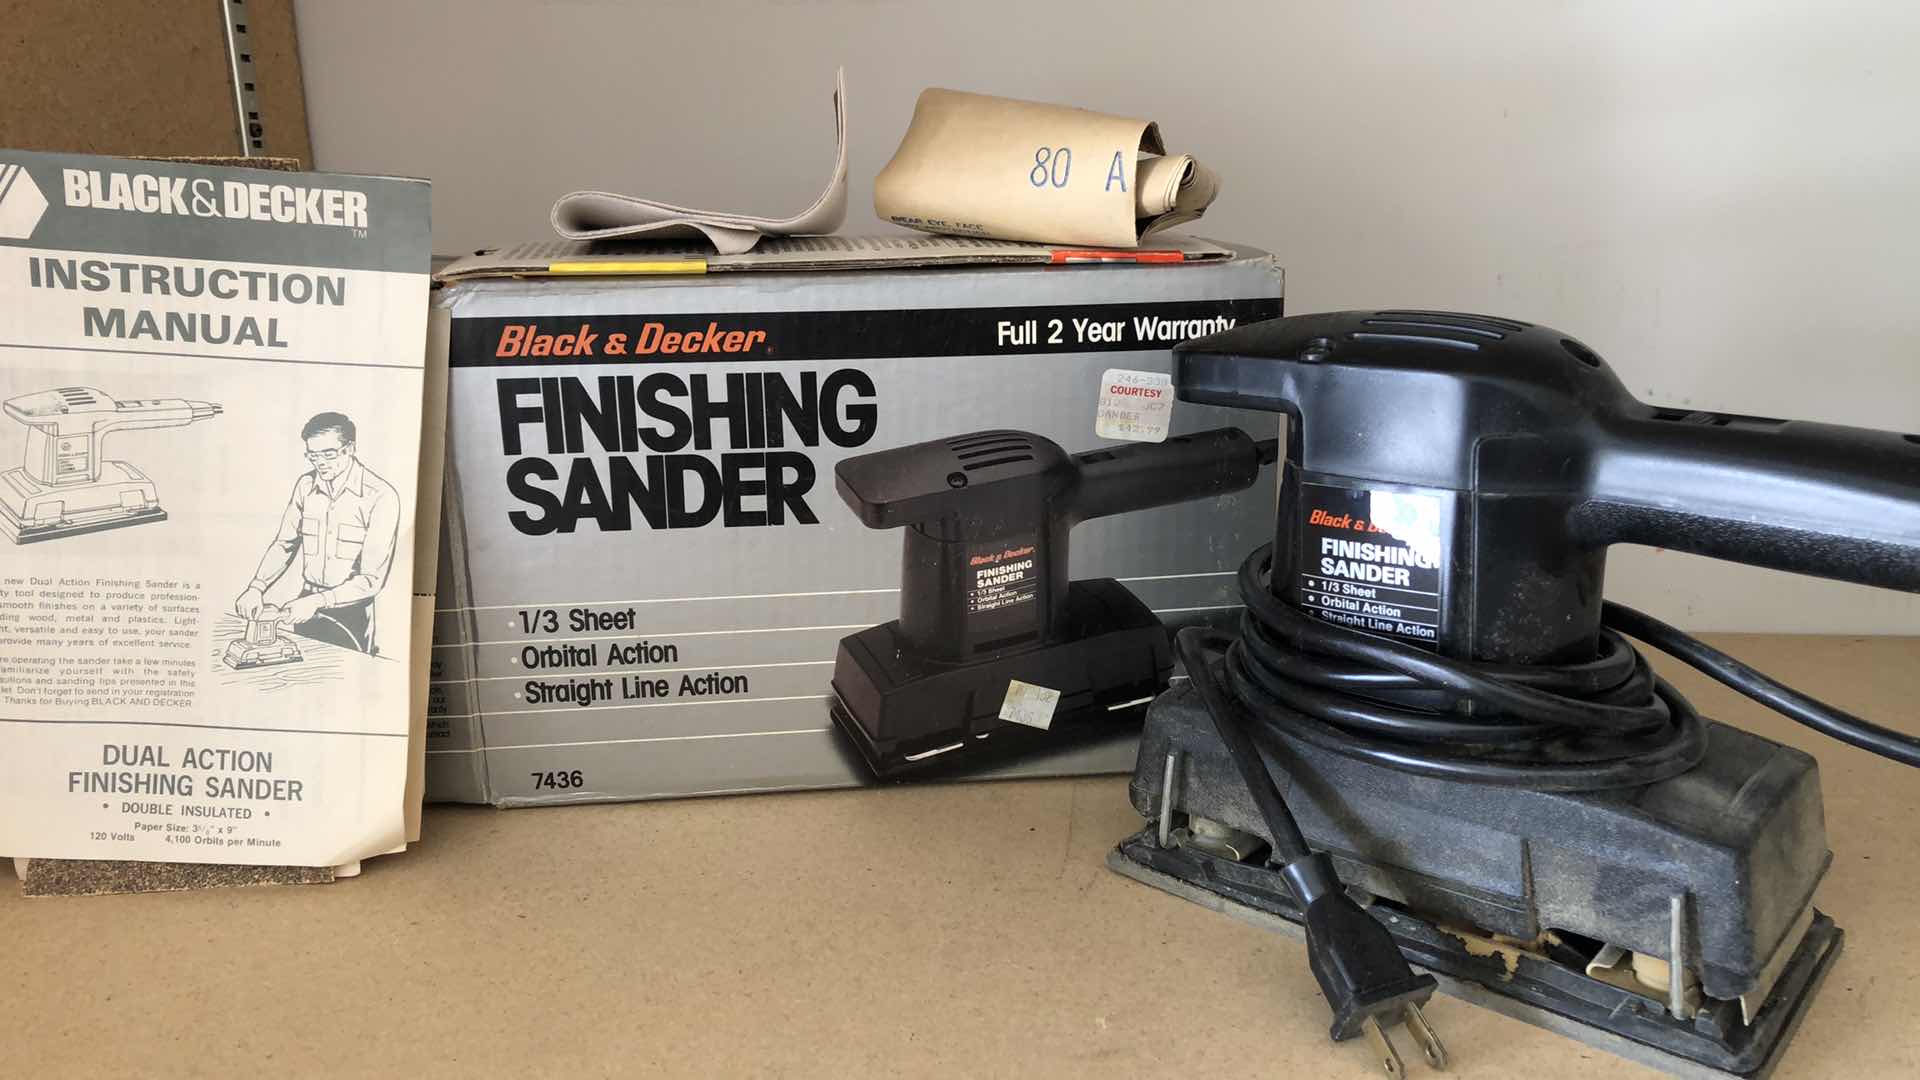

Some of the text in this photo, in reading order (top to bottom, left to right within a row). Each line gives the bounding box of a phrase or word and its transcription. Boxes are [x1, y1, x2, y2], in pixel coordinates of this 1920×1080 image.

[1030, 147, 1128, 193] 80 A
[29, 256, 346, 306] INSTRUCTION
[83, 306, 288, 348] MANUAL
[998, 320, 1037, 346] Full
[1047, 319, 1064, 344] 2
[1072, 317, 1126, 344] Year
[495, 322, 767, 358] Black & Decker
[1110, 385, 1162, 399] COURTESY
[496, 368, 878, 455] FINISHING
[506, 451, 820, 537] SANDER
[1309, 509, 1352, 529] Black
[1354, 520, 1364, 531] &
[976, 560, 1033, 579] FINISHING
[1321, 557, 1410, 586] SANDER
[4, 578, 24, 586] new
[30, 577, 53, 586] Dual
[58, 578, 90, 586] Action
[96, 578, 140, 589] Finishing
[145, 579, 178, 589] Sander
[976, 571, 1024, 588] SANDER
[40, 590, 84, 599] designed
[106, 591, 145, 601] produce
[1322, 581, 1376, 598] 1/3 Sheet
[39, 602, 77, 610] finishes
[111, 603, 144, 612] variety
[148, 603, 158, 611] of
[162, 604, 200, 613] surfaces
[1321, 595, 1401, 618] Orbital Action
[518, 607, 636, 634] 1/3 Sheet
[1322, 610, 1435, 638] Straight Line Action
[15, 626, 55, 634] versatile
[60, 626, 78, 634] and
[82, 627, 104, 636] easy
[144, 629, 166, 637] your
[169, 628, 199, 637] sander
[37, 638, 63, 647] many
[67, 639, 94, 647] years
[98, 638, 109, 646] of
[112, 639, 154, 647] excellent
[11, 657, 56, 666] operating
[78, 657, 110, 665] sander
[162, 659, 196, 667] minutes
[521, 641, 679, 669] Orbital Action
[56, 677, 95, 687] sanding
[120, 678, 166, 686] presented
[60, 668, 103, 676] yourself
[167, 669, 195, 678] safety
[44, 686, 72, 696] forget
[87, 687, 109, 695] send
[121, 688, 144, 697] your
[145, 689, 195, 698] registration
[524, 672, 749, 707] Straight Line Action
[4, 695, 192, 708] Thanks for Buying BLACK AND DECKER
[103, 744, 273, 773] DUAL ACTION
[68, 771, 303, 801] FINISHING SANDER
[531, 770, 584, 790] 7436
[121, 802, 252, 819] DOUBLE INSULATED
[134, 822, 163, 834] Paper
[166, 823, 189, 833] Size:
[90, 832, 107, 841] 120
[111, 832, 135, 842] Volts
[194, 836, 224, 846] Orbits
[227, 838, 244, 848] per
[247, 837, 281, 847] Minute
